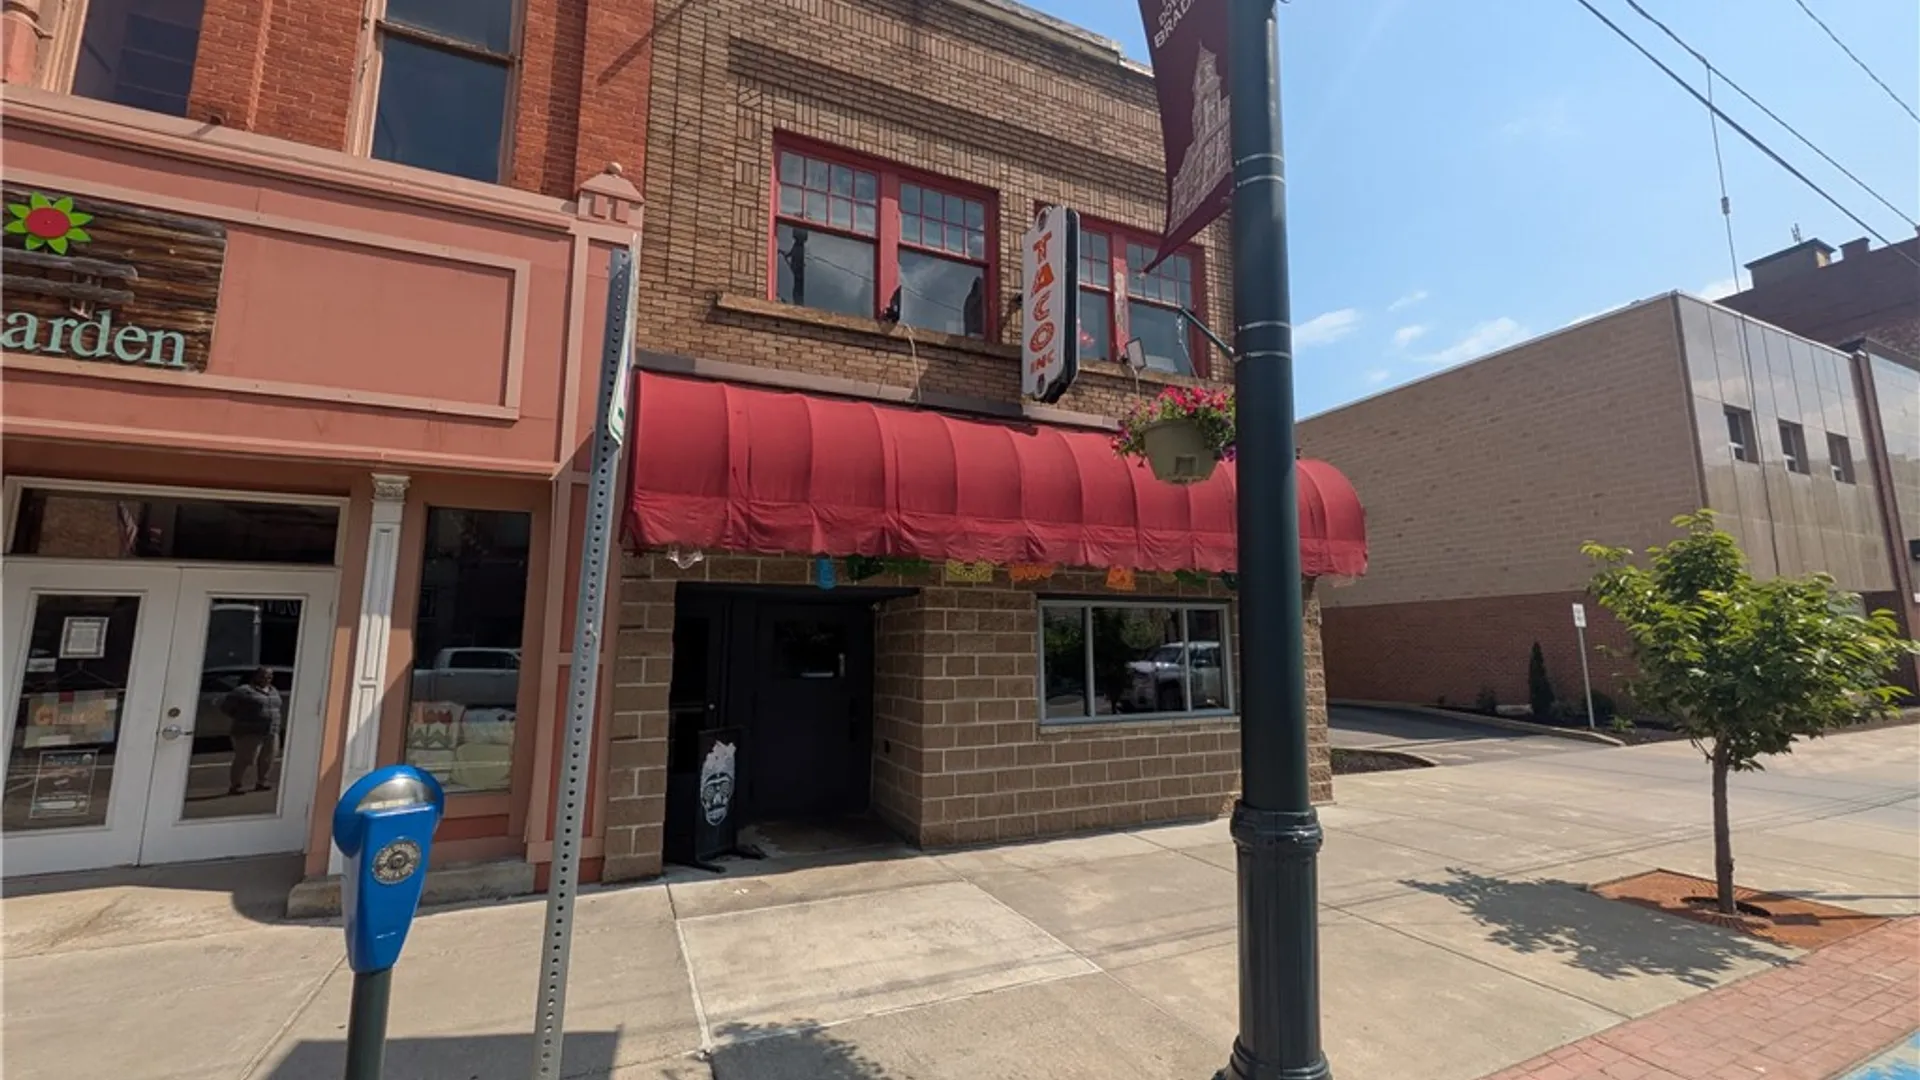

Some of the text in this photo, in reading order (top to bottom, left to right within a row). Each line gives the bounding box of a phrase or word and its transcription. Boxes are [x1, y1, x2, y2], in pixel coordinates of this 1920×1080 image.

[1154, 0, 1195, 48] BRAD
[1029, 231, 1055, 353] TACO
[0, 309, 188, 368] arden
[1029, 349, 1055, 375] INC
